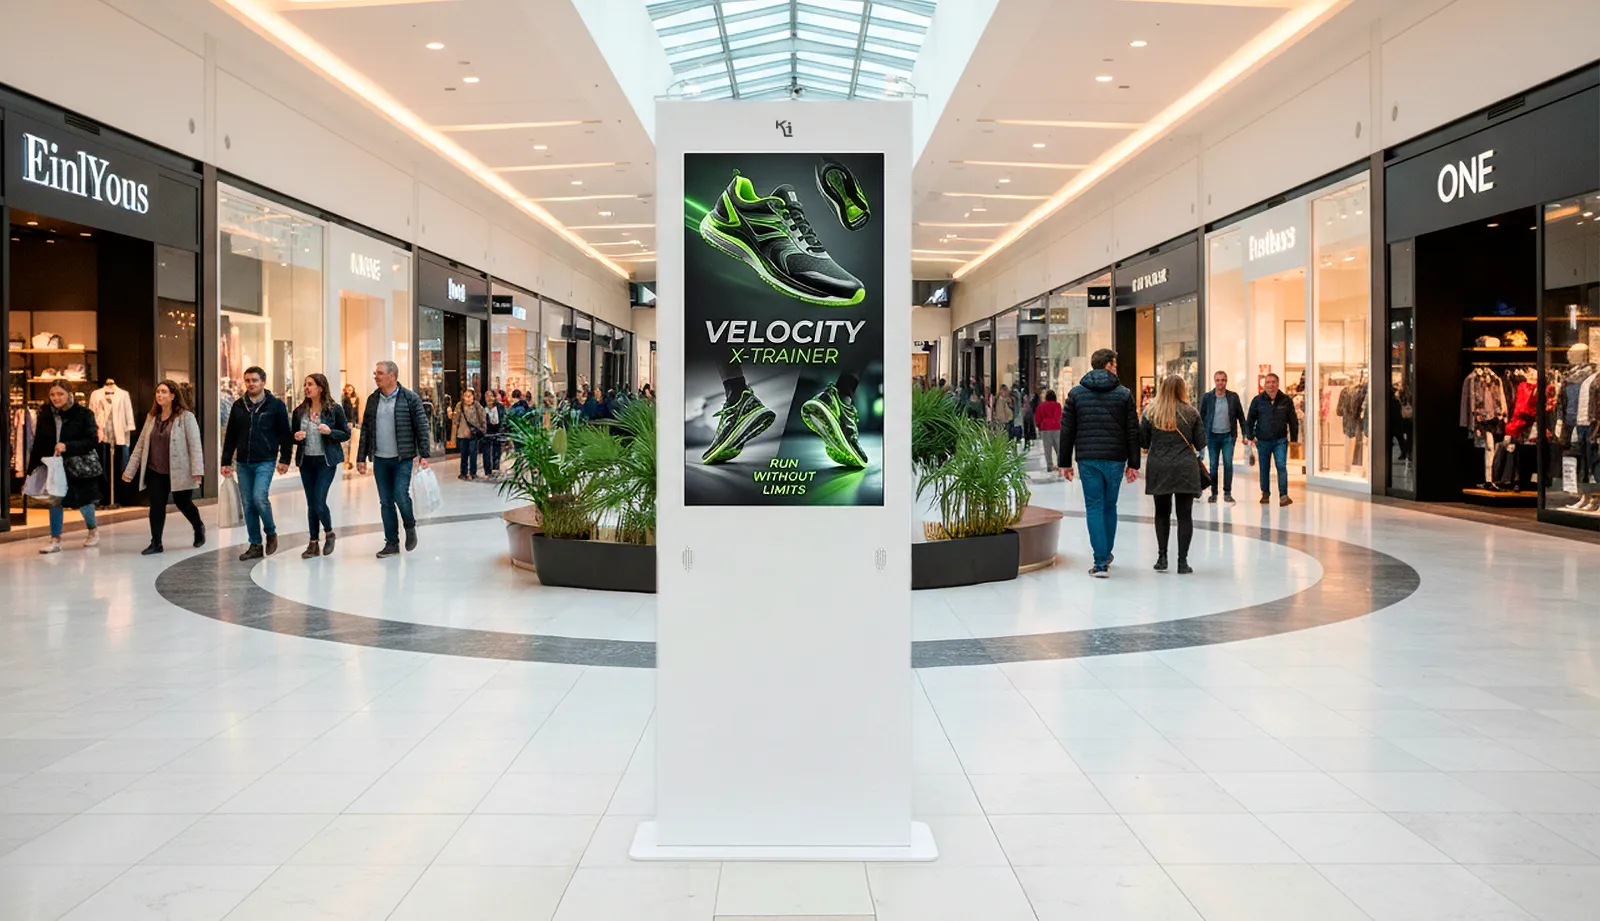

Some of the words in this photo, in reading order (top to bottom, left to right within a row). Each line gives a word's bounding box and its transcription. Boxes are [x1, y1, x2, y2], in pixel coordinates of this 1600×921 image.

[1437, 149, 1496, 203] ONE
[705, 320, 866, 344] VELOCITY
[728, 347, 839, 364] X-TRAINER
[769, 458, 799, 469] RUN
[753, 471, 817, 482] WITHOUT
[762, 484, 806, 495] LIMITS
